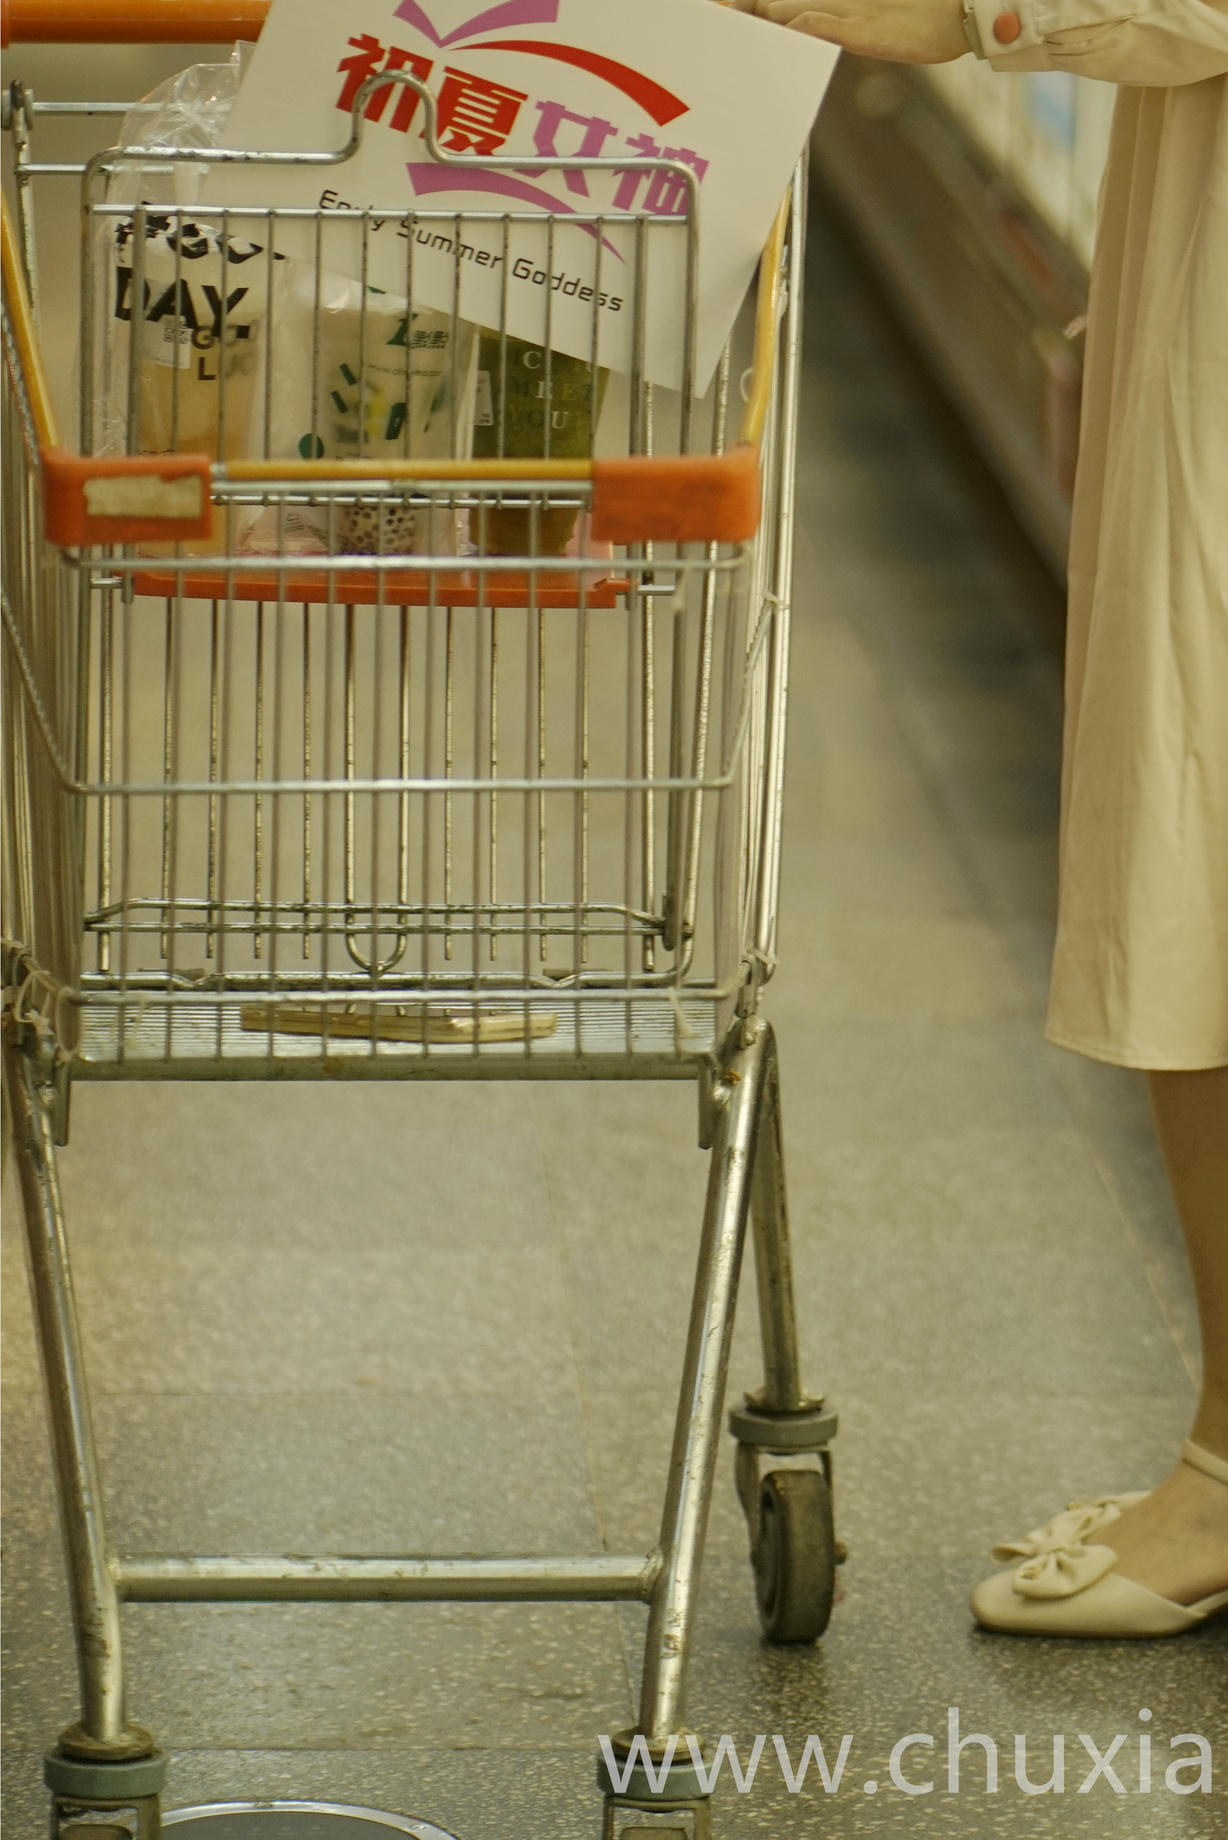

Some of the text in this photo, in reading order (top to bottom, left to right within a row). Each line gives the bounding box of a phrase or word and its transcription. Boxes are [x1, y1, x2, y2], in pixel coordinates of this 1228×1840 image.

[336, 33, 710, 215] 初夏女神
[397, 218, 623, 312] Summer Goddess
